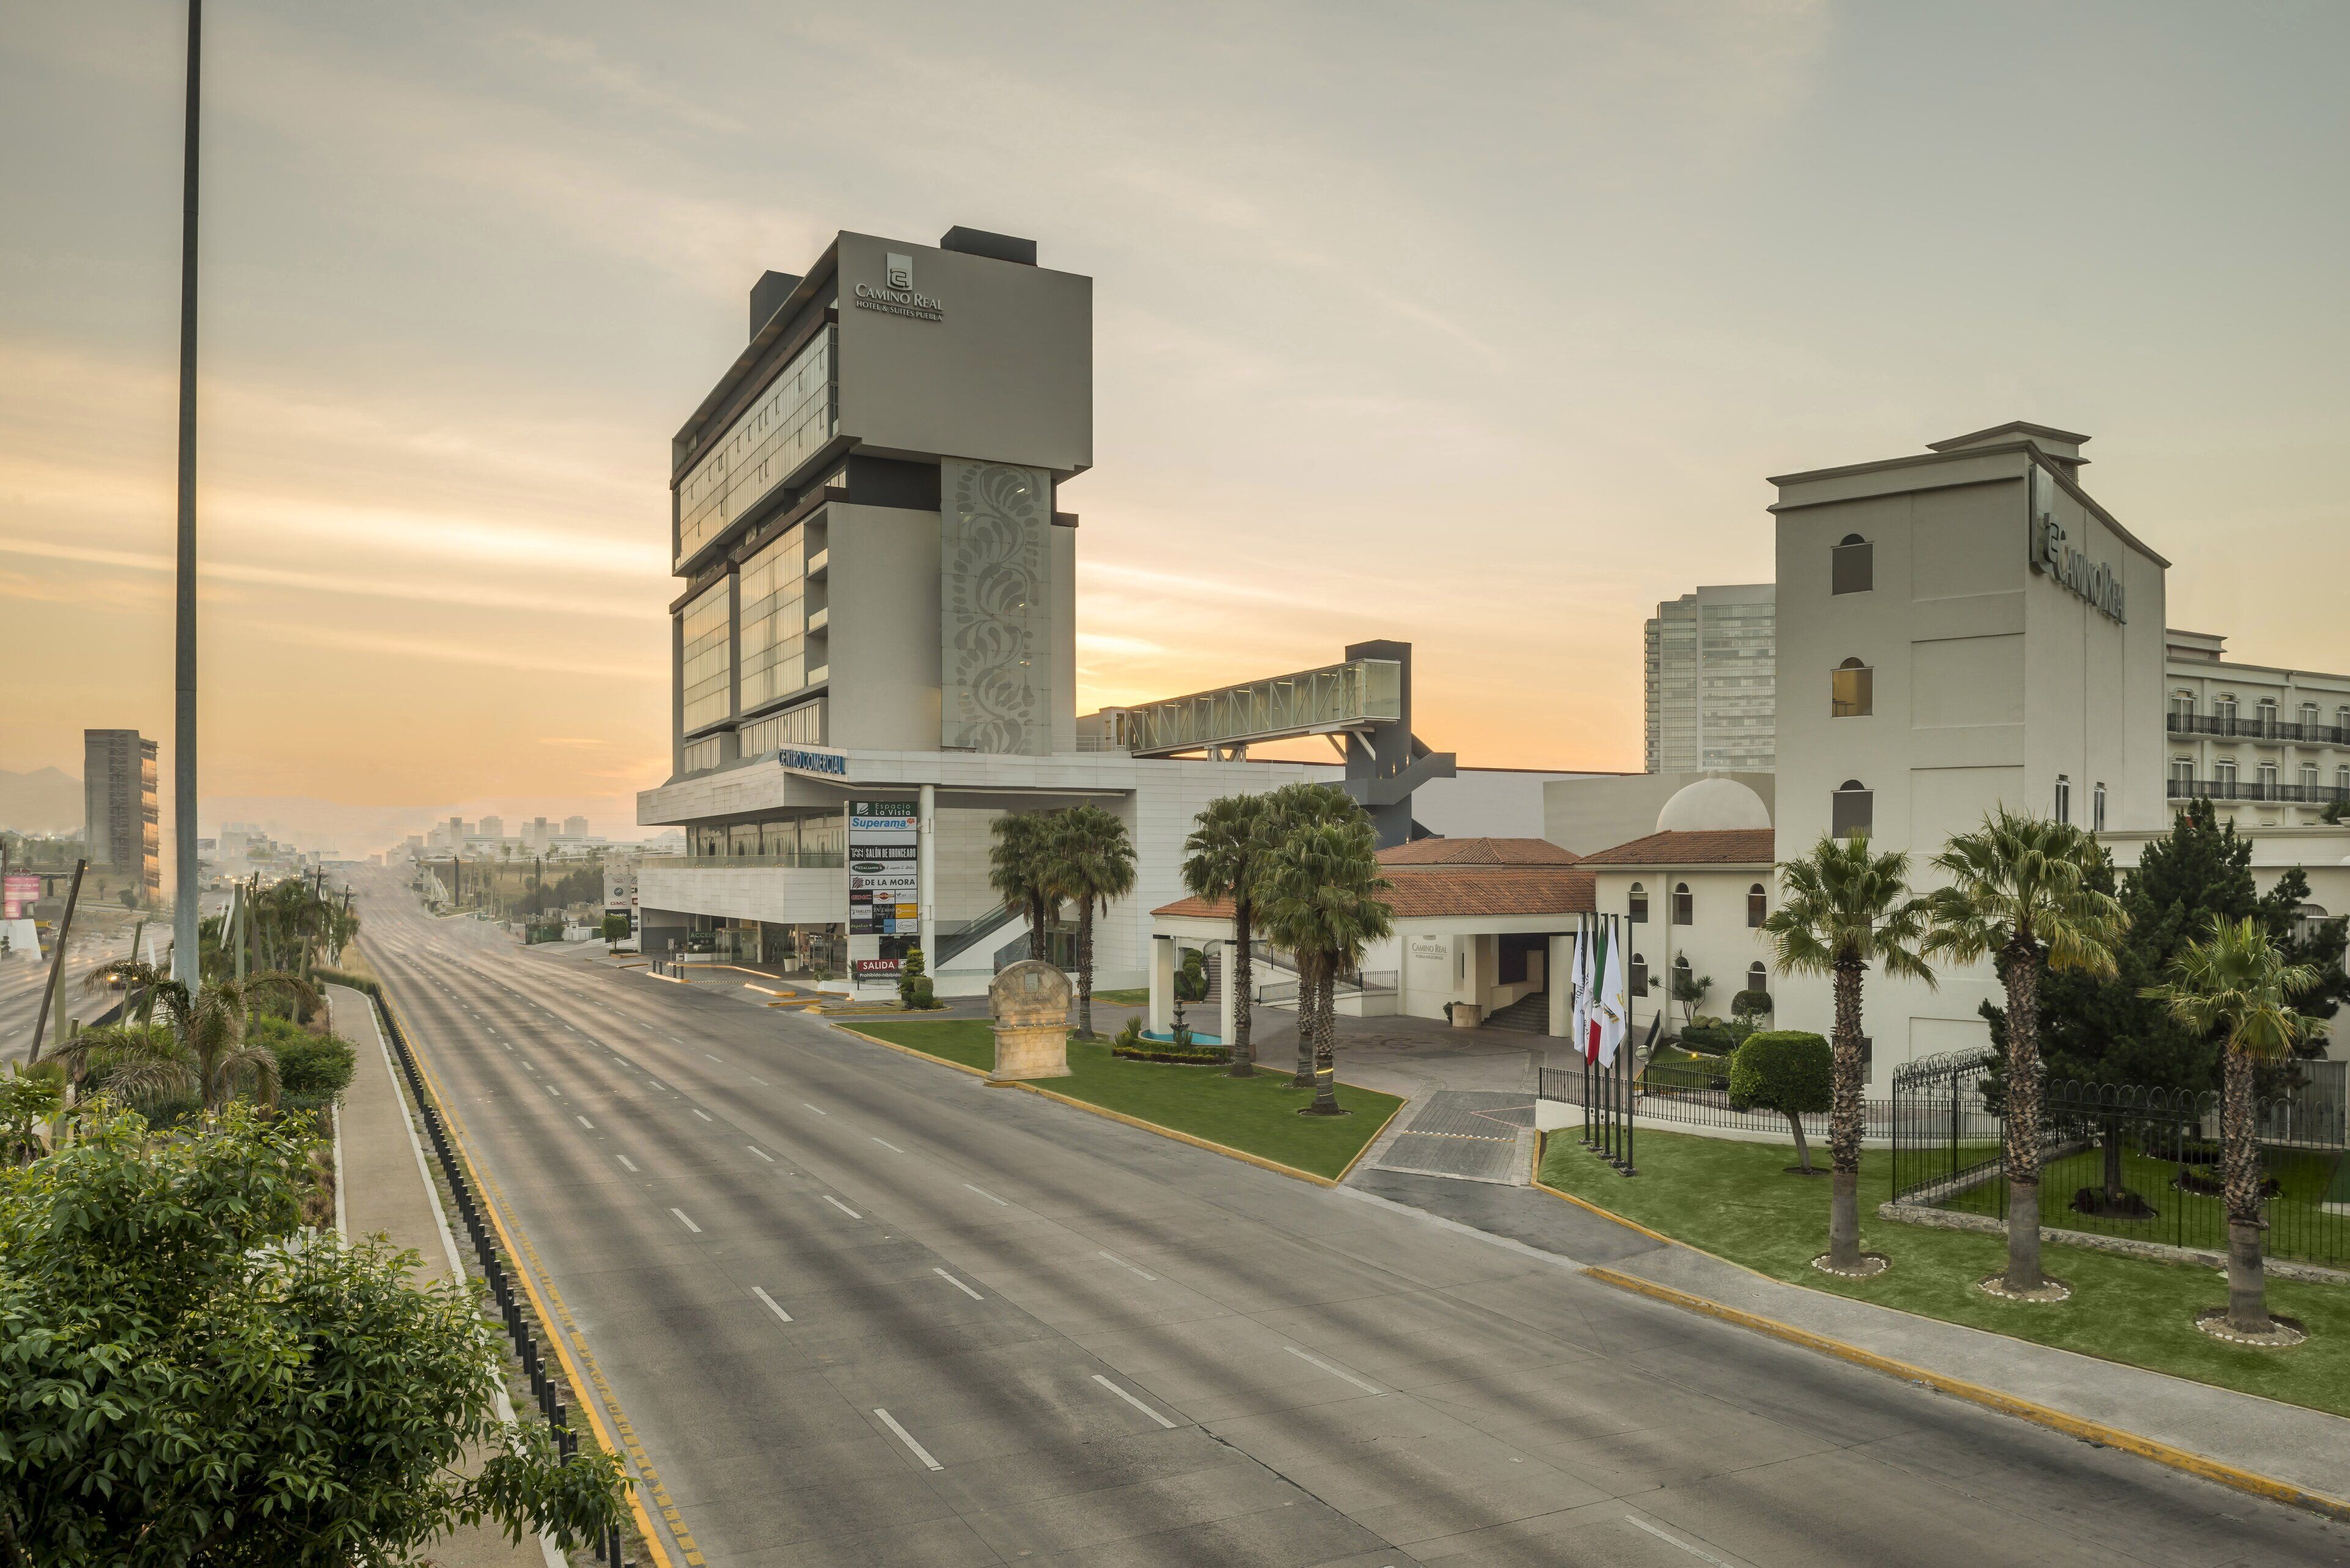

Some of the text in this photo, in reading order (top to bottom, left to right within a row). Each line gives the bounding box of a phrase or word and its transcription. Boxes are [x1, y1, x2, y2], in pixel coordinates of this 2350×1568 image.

[855, 283, 943, 310] CAMINO REAL
[856, 300, 880, 310] HOTEL
[890, 306, 914, 317] SUITES
[916, 311, 942, 321] PUEBLA
[2053, 529, 2103, 607] CAMINO
[778, 749, 846, 775] CENTRO COMERCIAL
[852, 817, 906, 829] Superama
[865, 846, 916, 858] SALÓN DE BRONCEADO
[1412, 943, 1447, 954] CAMINO REAL
